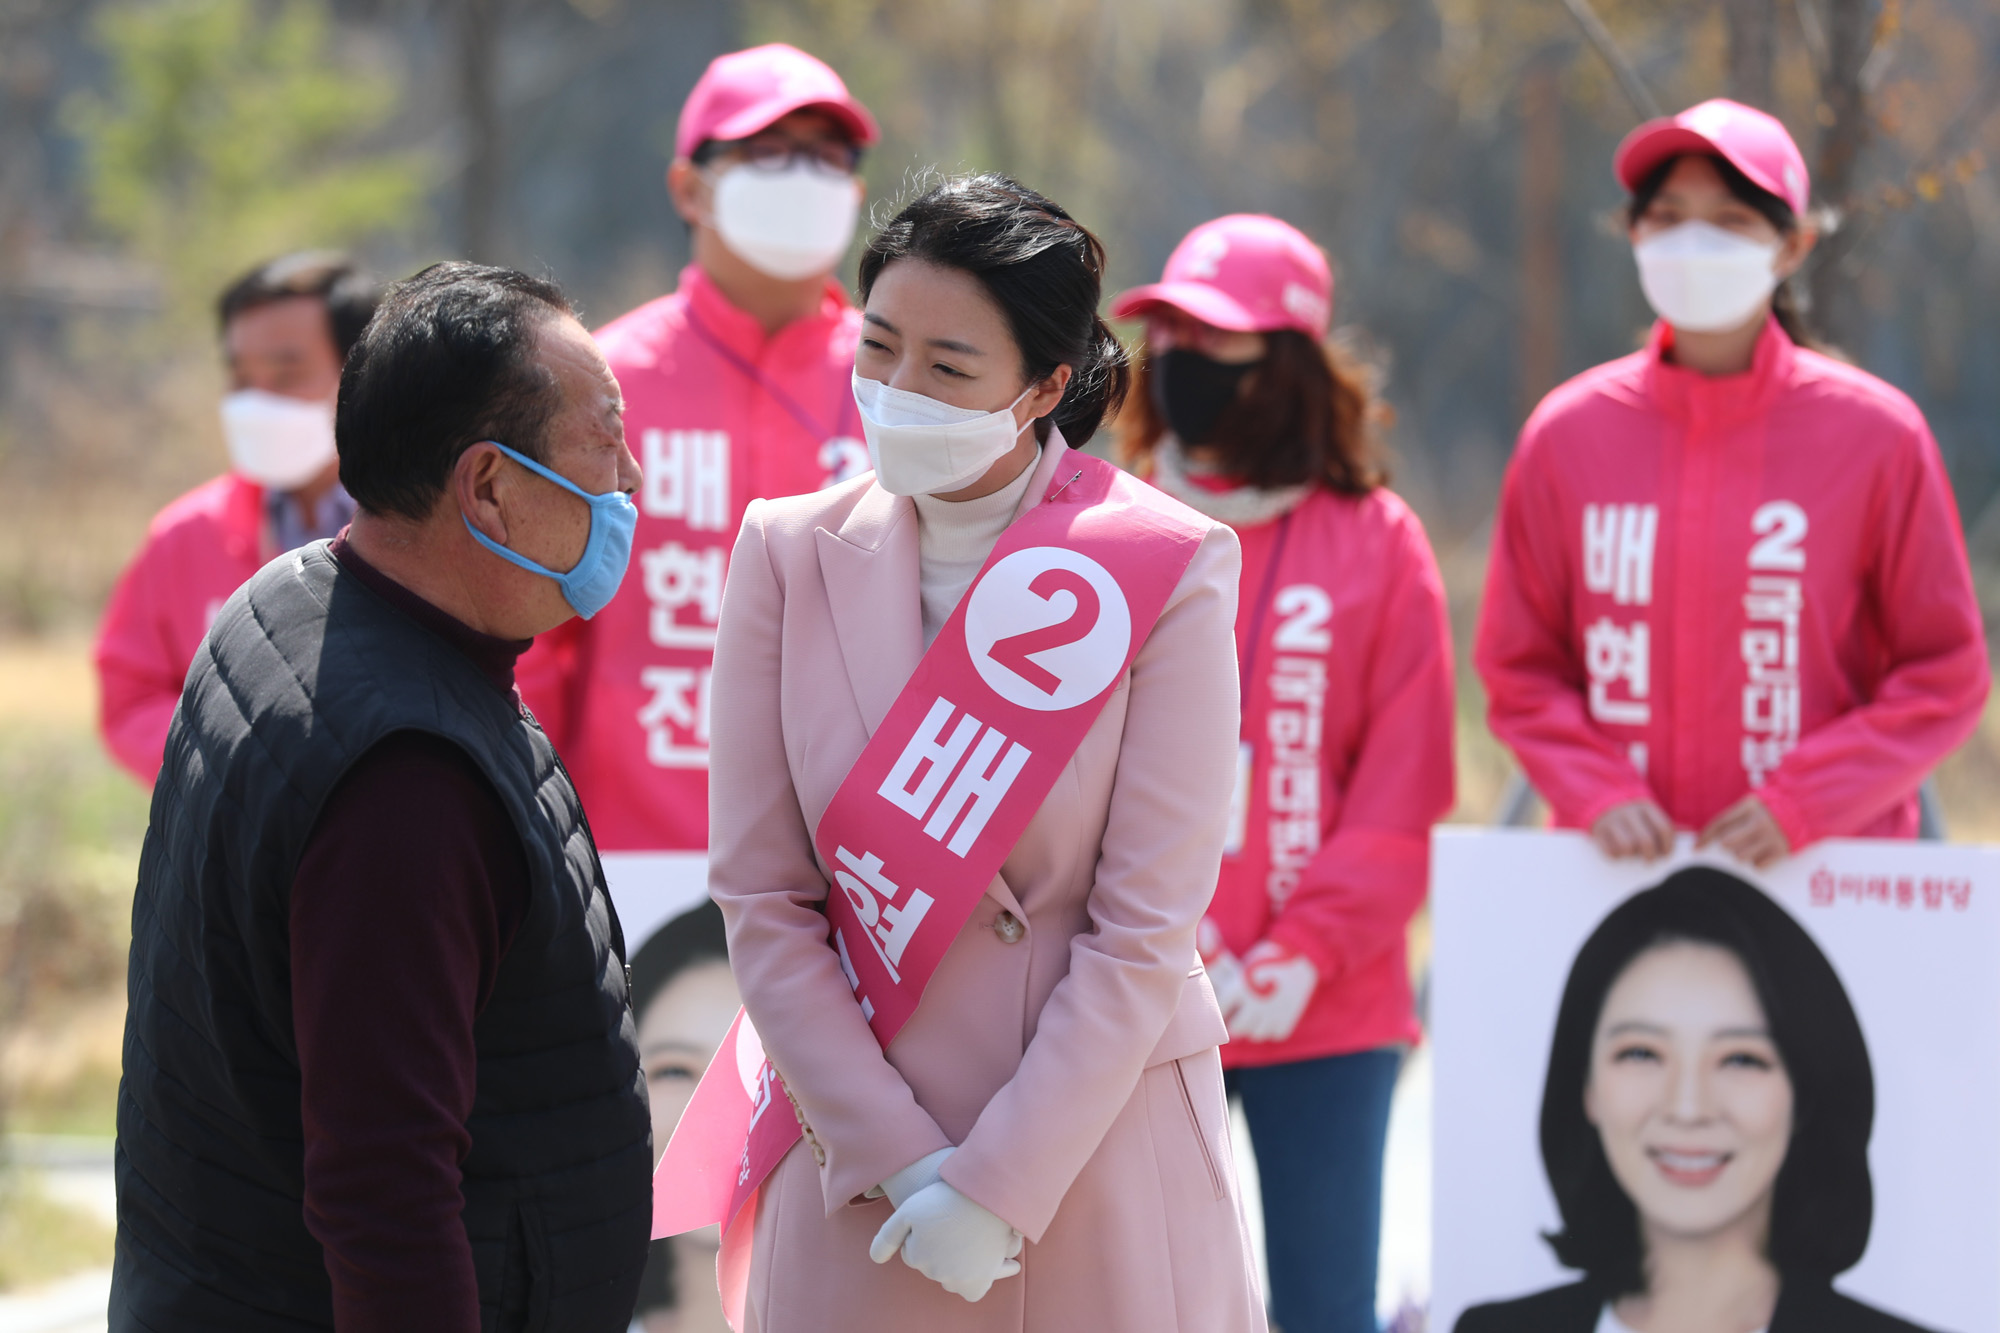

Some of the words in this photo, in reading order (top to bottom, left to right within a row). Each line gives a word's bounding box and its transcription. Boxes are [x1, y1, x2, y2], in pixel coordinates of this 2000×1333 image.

[818, 437, 874, 491] 2
[636, 428, 730, 770] 배현진
[1748, 499, 1808, 572] 2
[987, 568, 1100, 696] 2
[1272, 584, 1333, 653] 2
[1583, 503, 1658, 773] 배현
[834, 696, 1032, 1022] 배현
